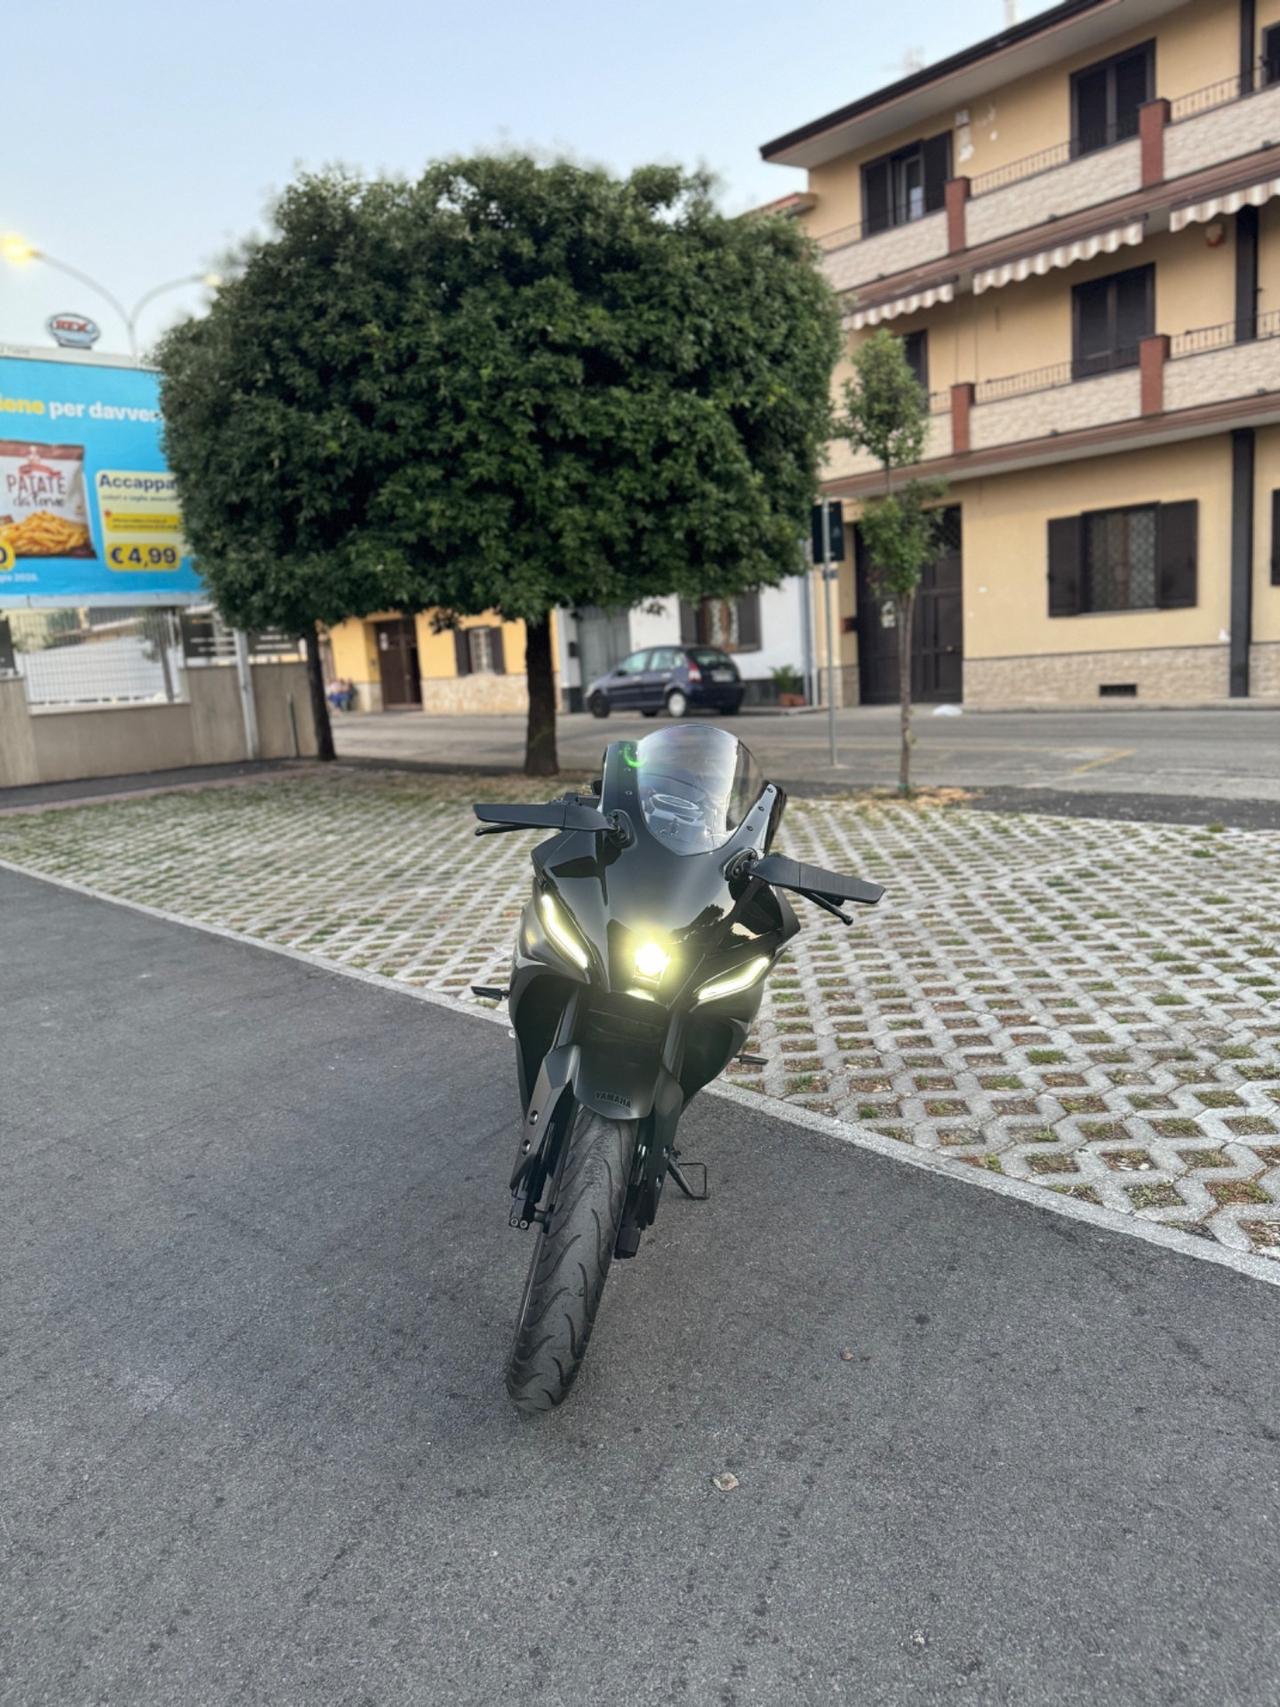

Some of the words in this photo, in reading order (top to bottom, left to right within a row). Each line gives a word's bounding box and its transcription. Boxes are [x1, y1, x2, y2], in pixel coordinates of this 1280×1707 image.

[54, 319, 90, 334] REX
[49, 401, 85, 419] per
[89, 400, 162, 422] davver
[6, 474, 66, 496] PATATE
[111, 547, 124, 565] €
[128, 547, 176, 568] 4,99
[594, 1091, 631, 1109] YAMAHA
